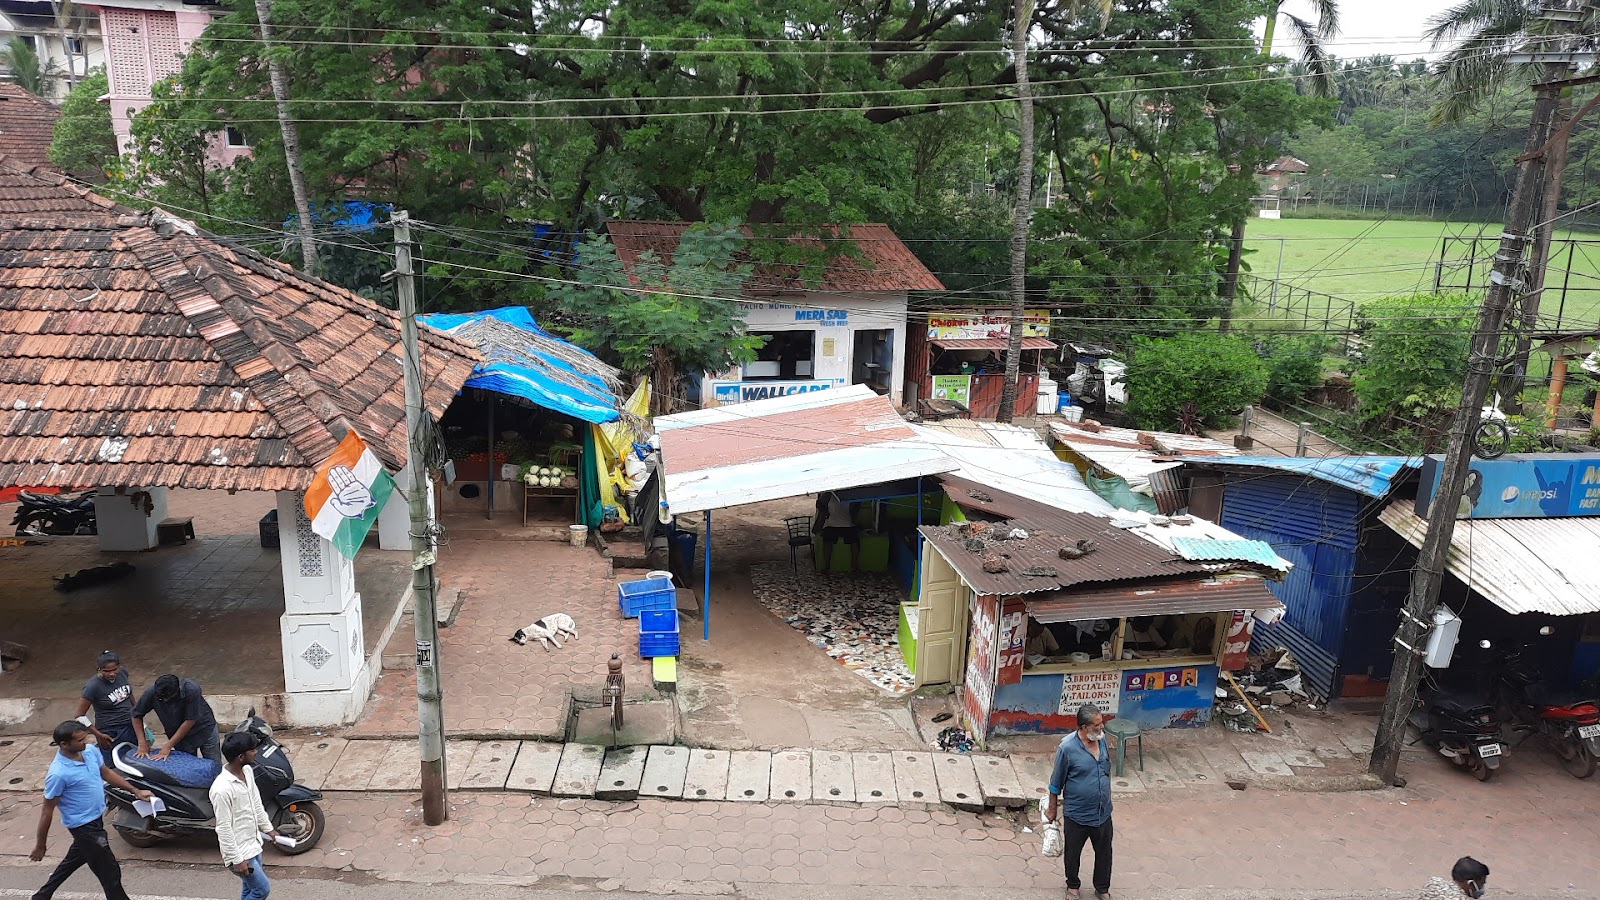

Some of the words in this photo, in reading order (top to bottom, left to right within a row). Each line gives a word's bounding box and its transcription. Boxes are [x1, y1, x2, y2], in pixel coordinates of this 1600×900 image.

[795, 310, 825, 320] MERA
[1579, 498, 1599, 508] FAST
[1065, 674, 1072, 683] 3
[1071, 691, 1108, 700] TAILORS
